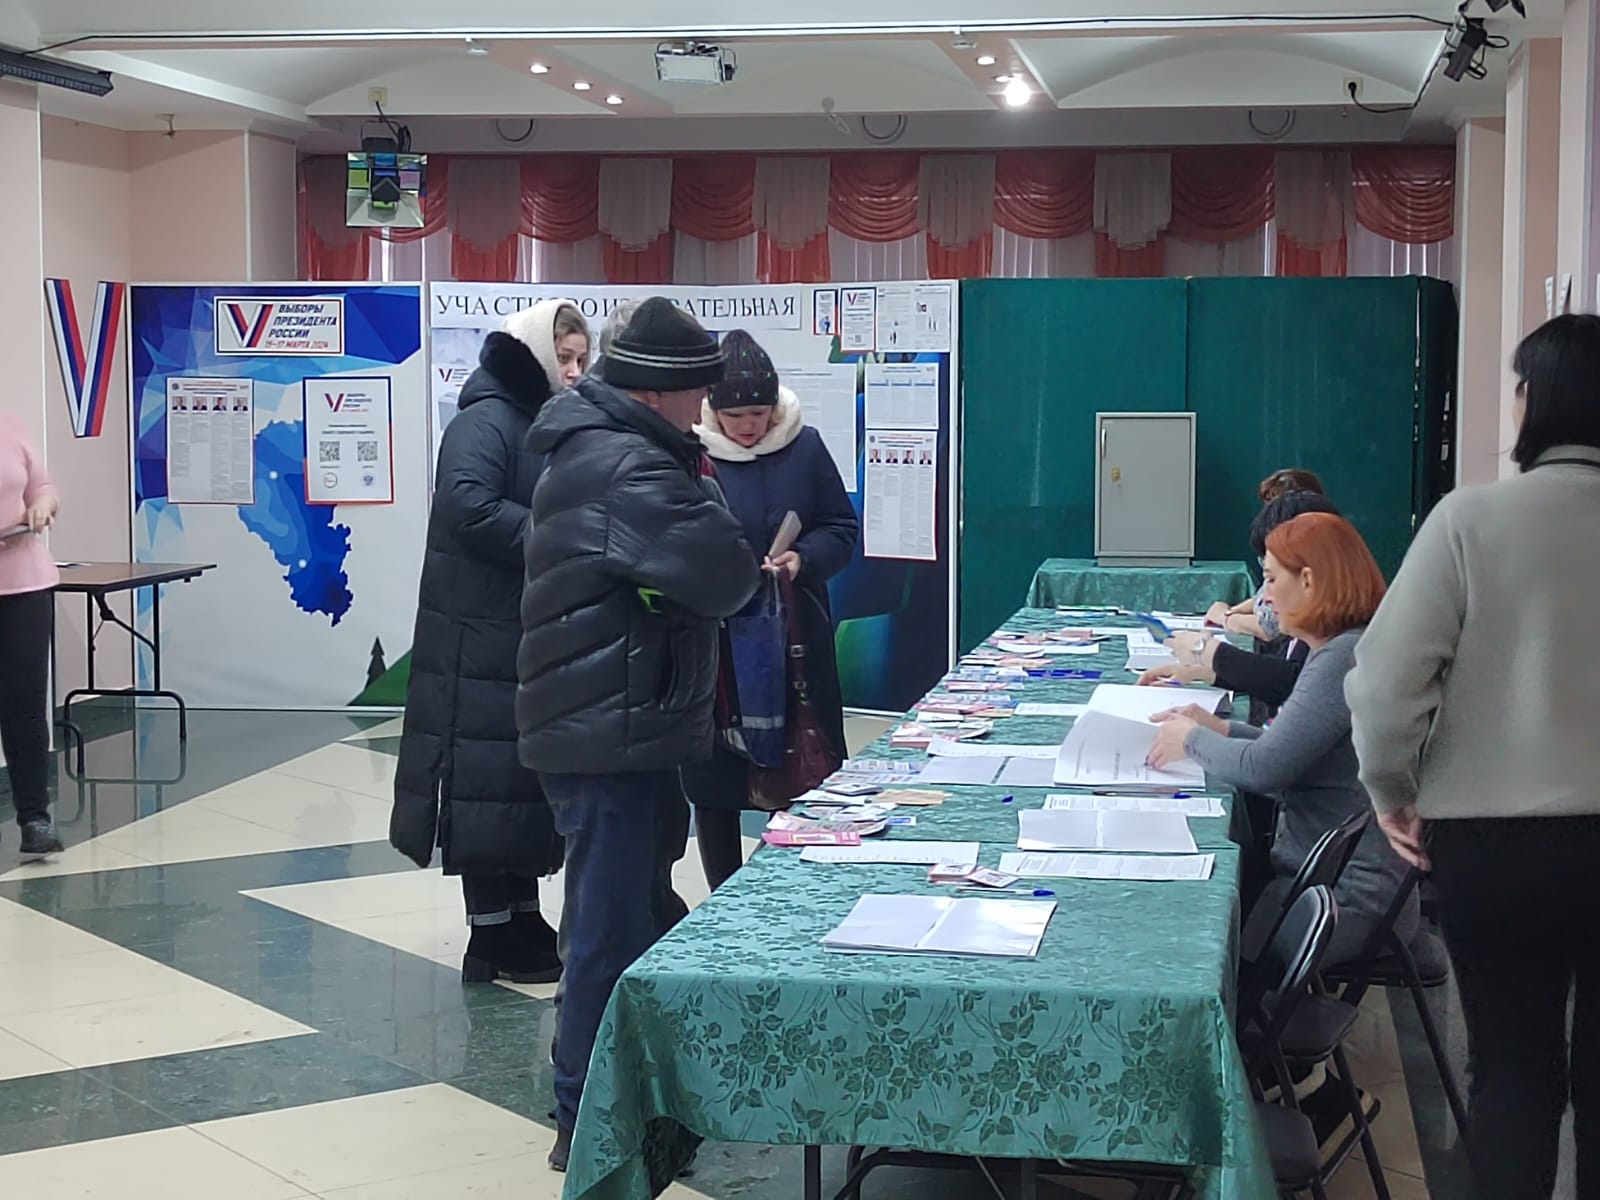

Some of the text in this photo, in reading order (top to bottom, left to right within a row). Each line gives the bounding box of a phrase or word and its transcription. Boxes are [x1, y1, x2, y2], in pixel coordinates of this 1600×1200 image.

[278, 304, 324, 313] ВЫБОРЫ
[273, 316, 337, 326] ПРЕЗИДЕНТА
[268, 329, 310, 338] РОССИИ
